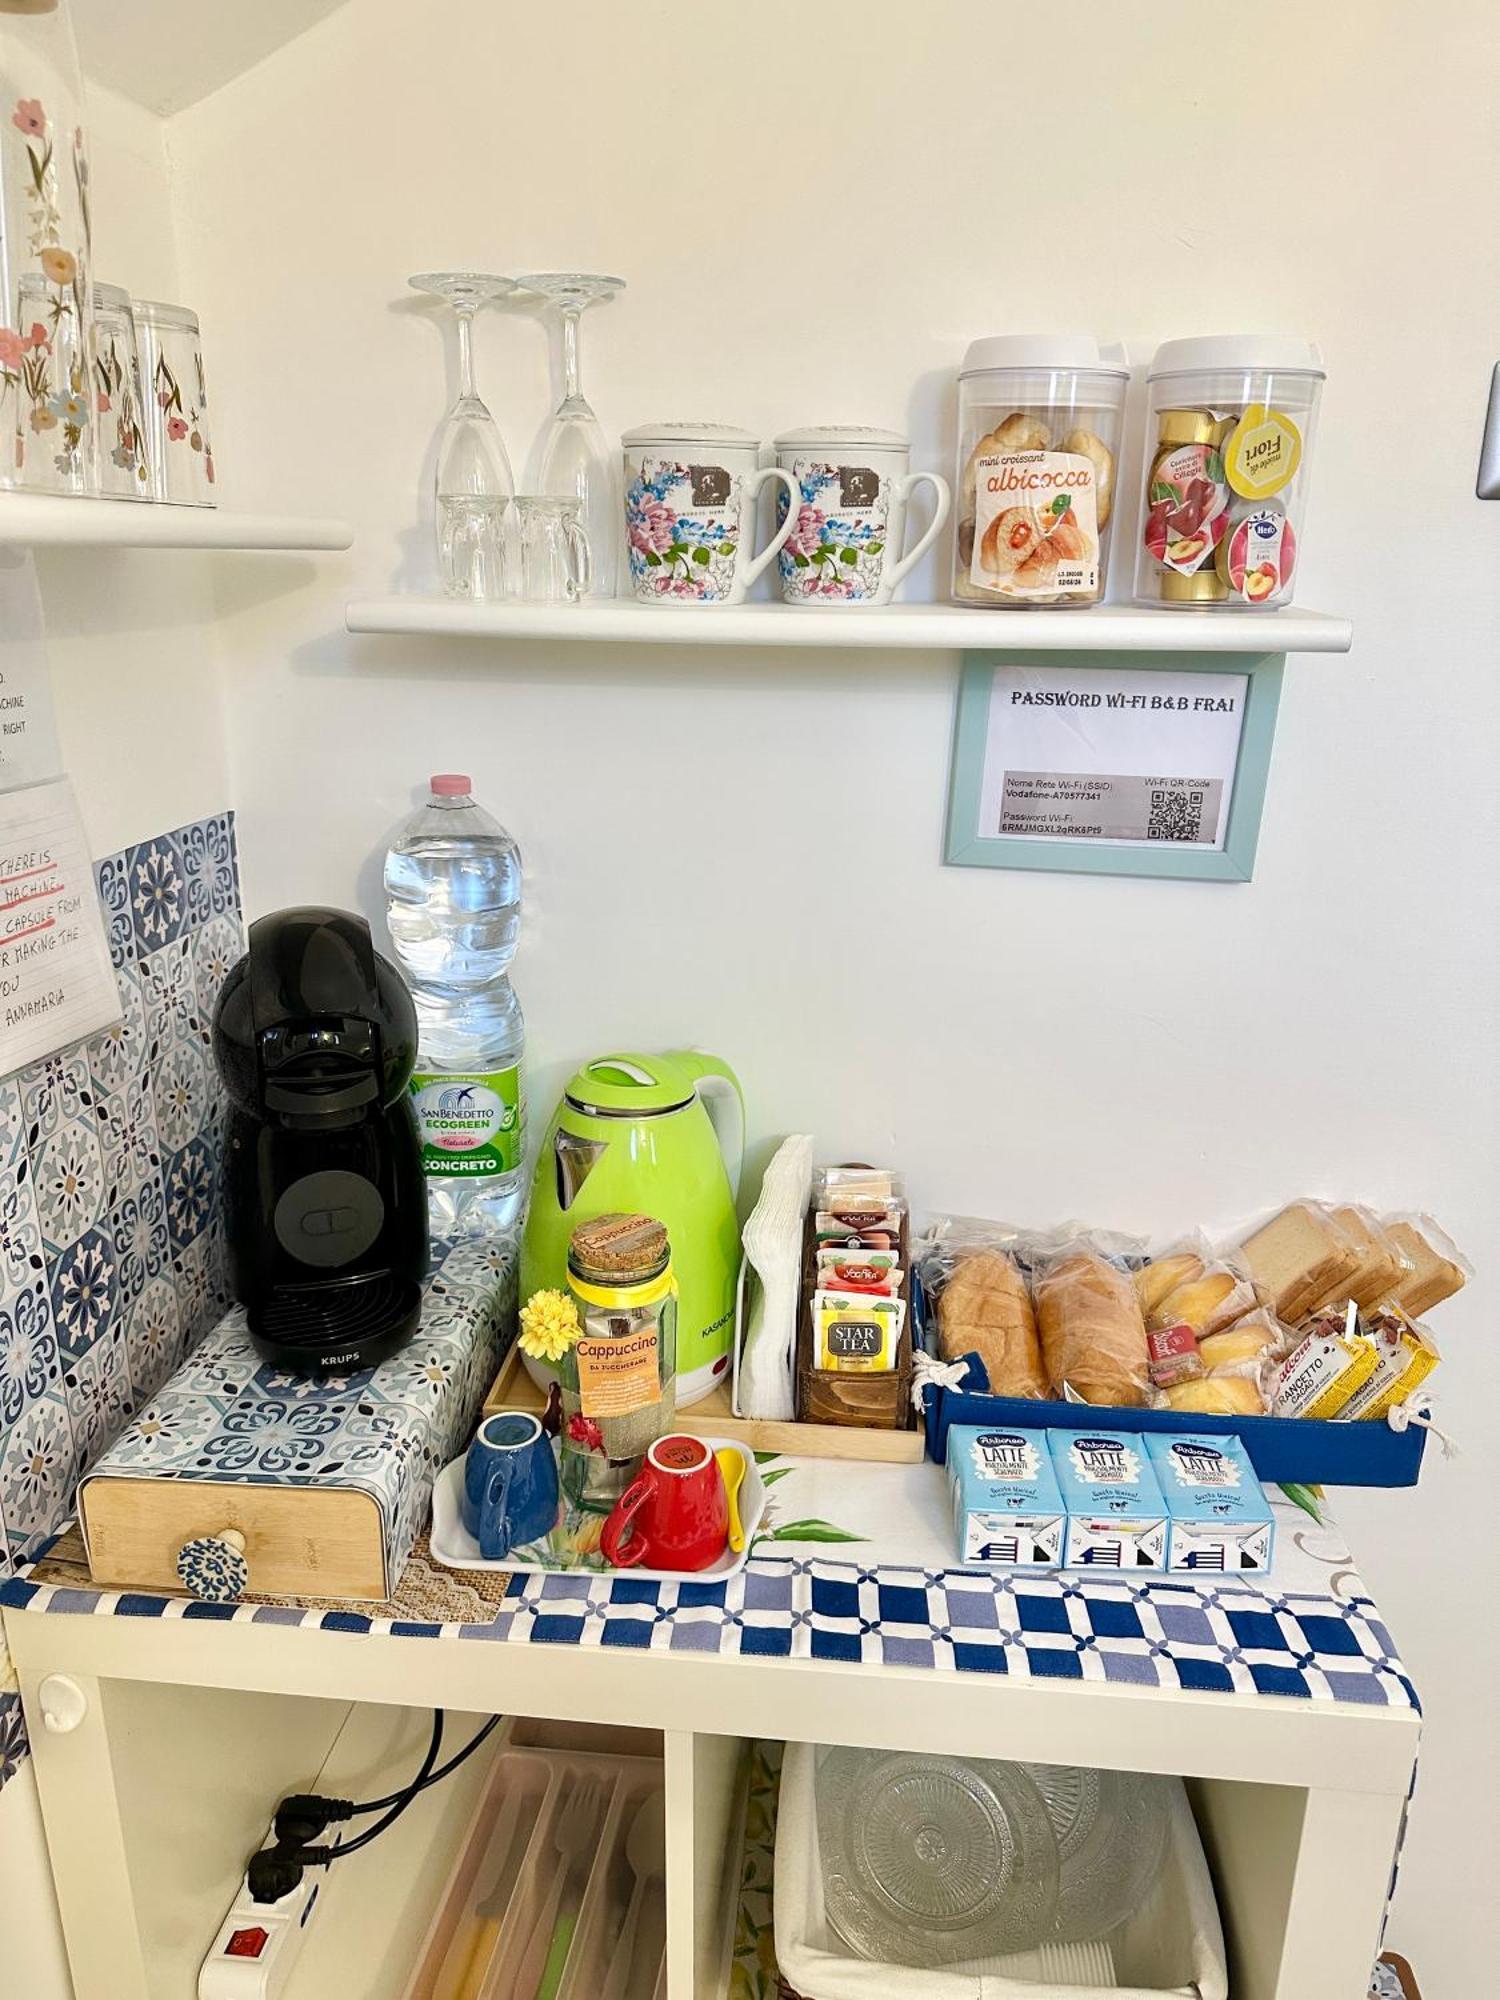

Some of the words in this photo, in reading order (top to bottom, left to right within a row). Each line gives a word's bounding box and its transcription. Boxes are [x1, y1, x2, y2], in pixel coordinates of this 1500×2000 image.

[1246, 435, 1281, 466] Fiori
[980, 456, 999, 467] mini
[1000, 453, 1046, 465] croissant
[987, 467, 1091, 493] albicocca
[1257, 525, 1276, 534] Hero
[0, 696, 24, 710] CHINE
[1011, 690, 1101, 708] PASSWORD
[1106, 692, 1147, 709] WI-FI
[1151, 696, 1189, 710] B&B
[1193, 697, 1234, 712] FRAI
[3, 721, 26, 735] RIGHT
[1007, 778, 1033, 788] Nome
[1036, 779, 1056, 789] Rete
[1058, 780, 1082, 790] Wi-Fi
[1084, 781, 1113, 791] (SSID)
[1144, 778, 1168, 787] Wi-Fi
[1170, 779, 1210, 788] QR-Code
[1003, 811, 1046, 822] Password
[1049, 814, 1073, 823] Wi-Fi
[0, 852, 36, 876] THERE
[40, 850, 51, 863] IS
[6, 905, 54, 933] CAPSULE
[58, 896, 80, 914] FROM
[0, 951, 10, 968] R
[15, 934, 56, 963] MAKING
[59, 927, 79, 944] THE
[6, 988, 64, 1026] ANNAMARIA
[426, 1120, 490, 1128] ECOGREEN
[442, 1137, 475, 1146] Naturale
[835, 1326, 874, 1340] STAR
[576, 1336, 657, 1360] Cappuccino
[840, 1339, 870, 1351] TEA
[321, 1351, 360, 1366] KRUPS
[1278, 1336, 1311, 1384] alconi
[1278, 1357, 1324, 1406] RANCETTO
[1291, 1378, 1315, 1404] CACAO
[1350, 1376, 1375, 1402] CACAO
[980, 1435, 1024, 1445] Arborea
[1077, 1440, 1122, 1449] Arborea
[982, 1448, 1025, 1462] LATTE
[1175, 1444, 1219, 1457] Arborea
[1080, 1452, 1125, 1466] LATTE
[1180, 1456, 1222, 1473] LATTE
